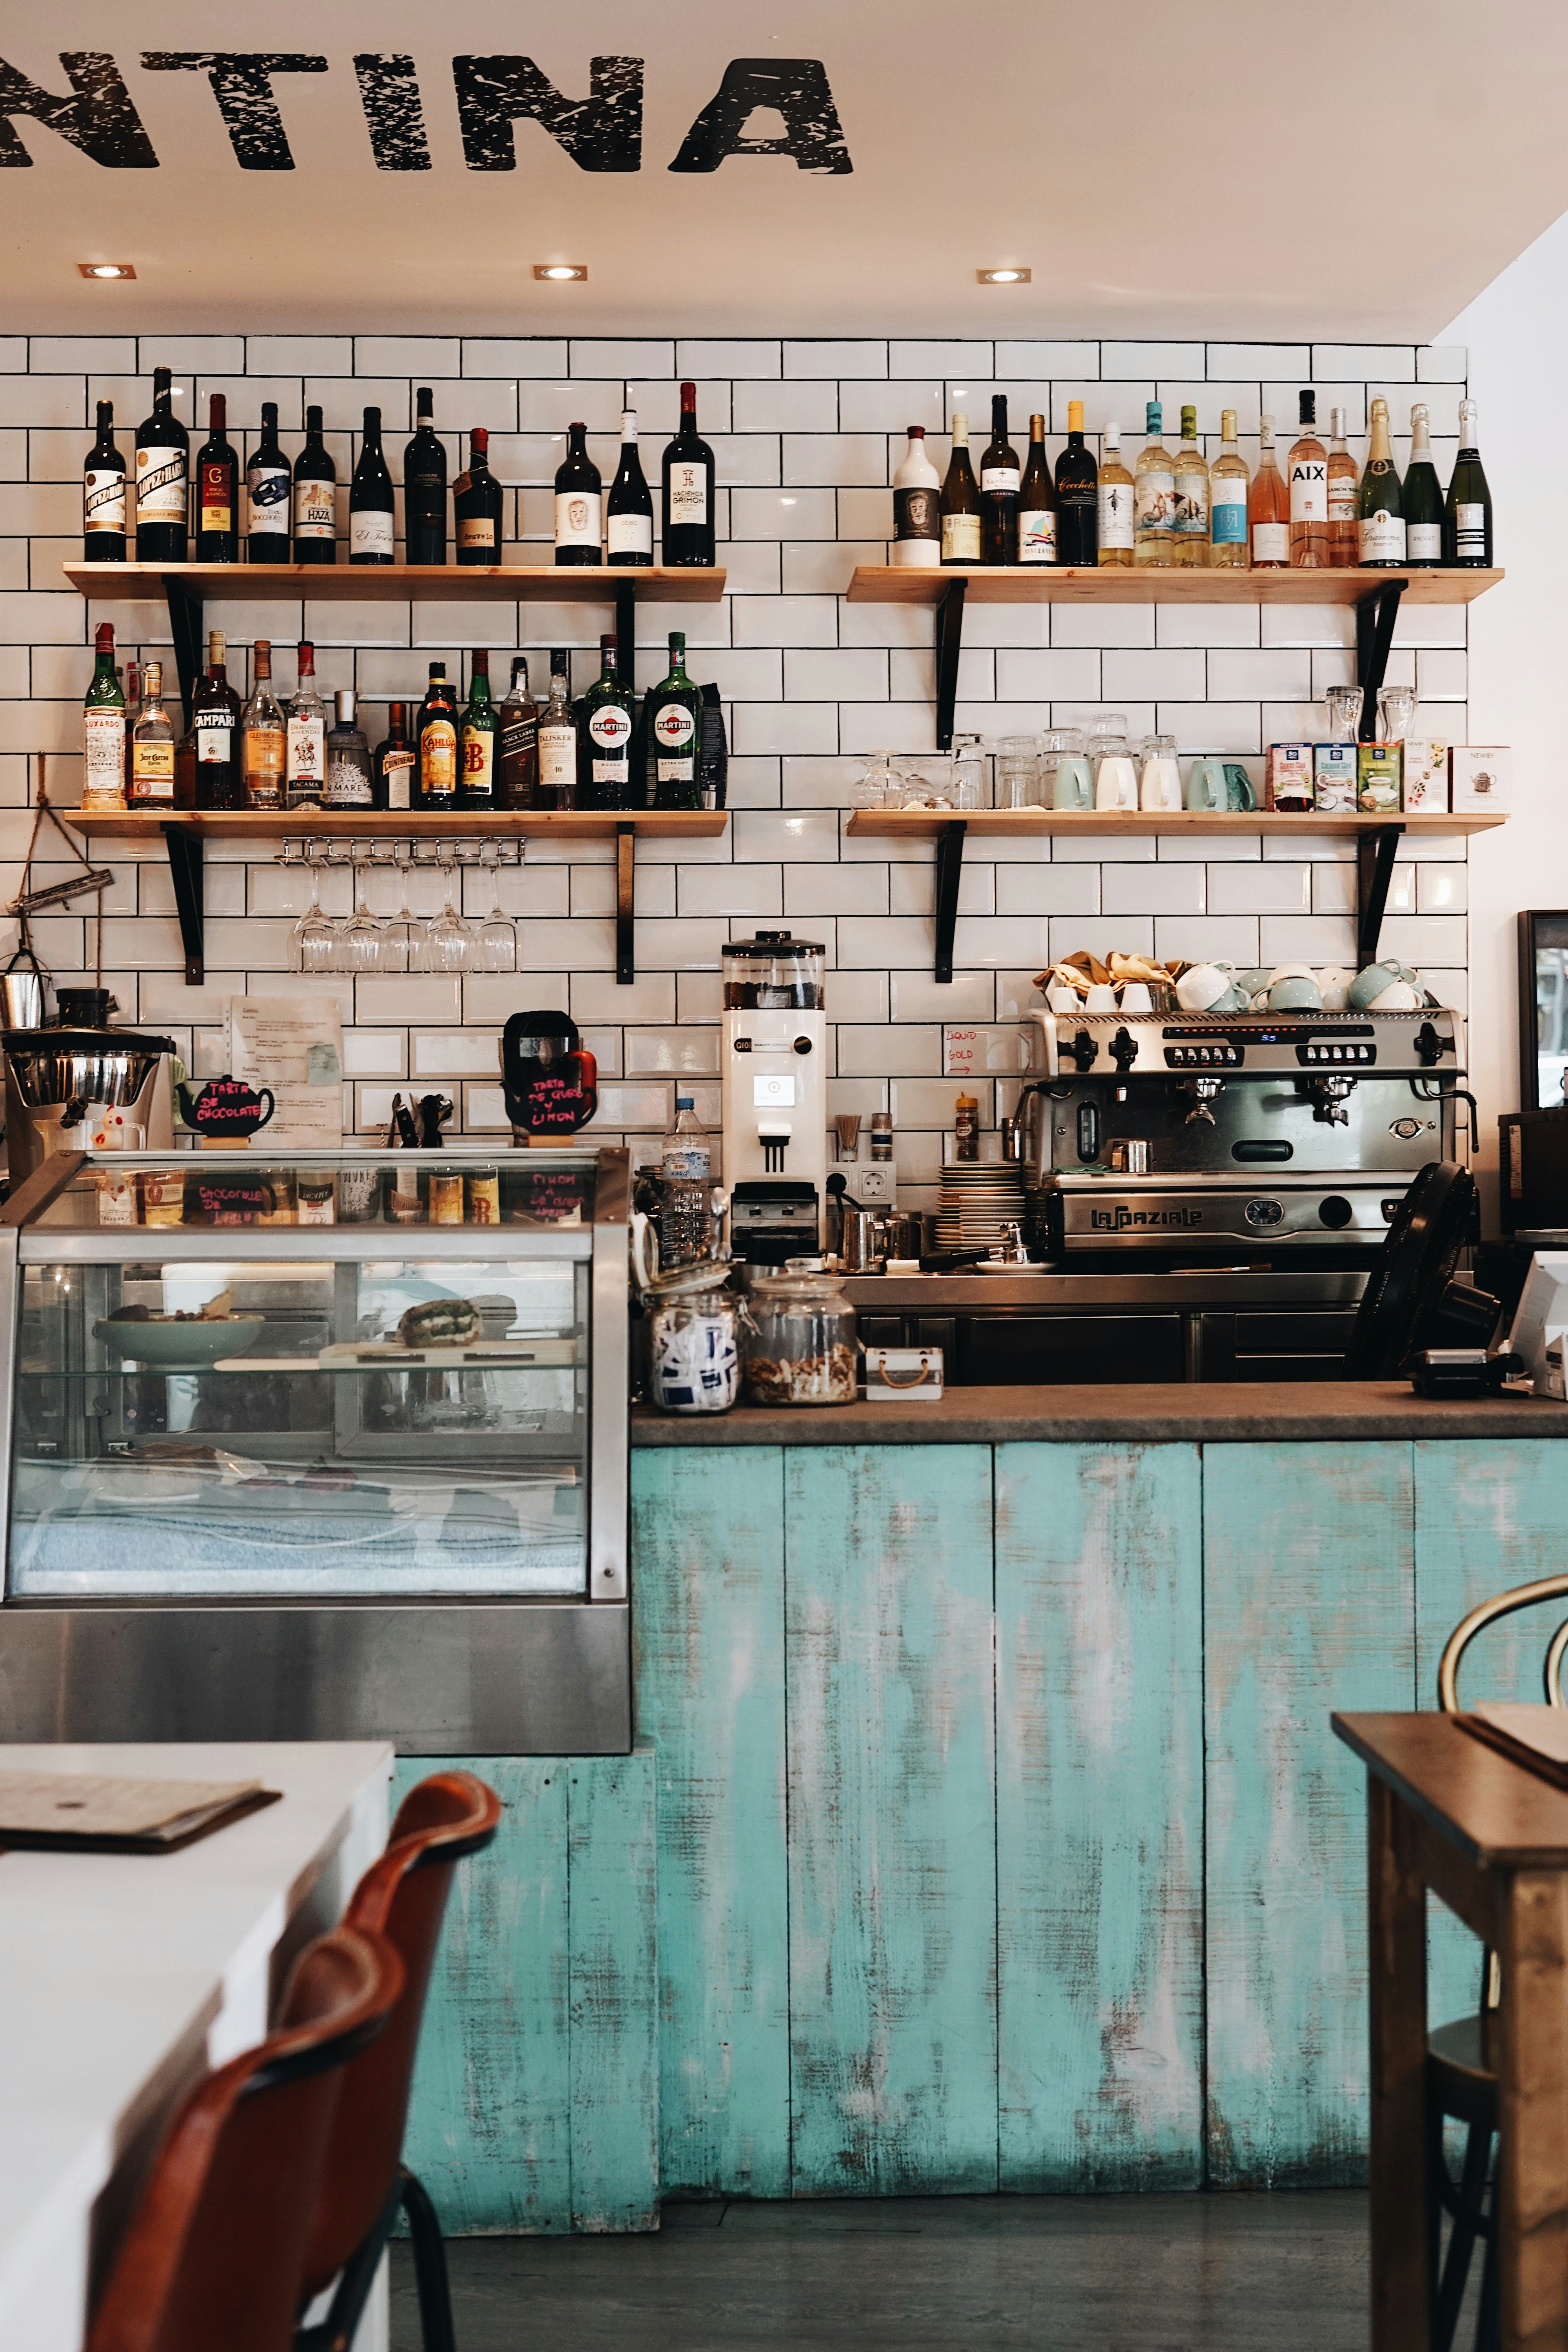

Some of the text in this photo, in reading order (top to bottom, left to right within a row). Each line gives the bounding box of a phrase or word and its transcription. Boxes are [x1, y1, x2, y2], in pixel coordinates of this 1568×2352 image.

[1292, 466, 1325, 481] AIX
[138, 470, 162, 498] LOPEZ
[308, 510, 330, 521] HAZA
[195, 715, 235, 728] CAMPARI
[658, 721, 690, 730] MARTINI
[502, 728, 535, 744] BLACK LABEL
[421, 734, 456, 753] KAHLÚA
[949, 1050, 973, 1060] GOLD
[209, 1082, 249, 1096] TARTA
[200, 1098, 219, 1109] DE
[544, 1101, 553, 1112] Y
[197, 1105, 261, 1121] CHOCOLATE
